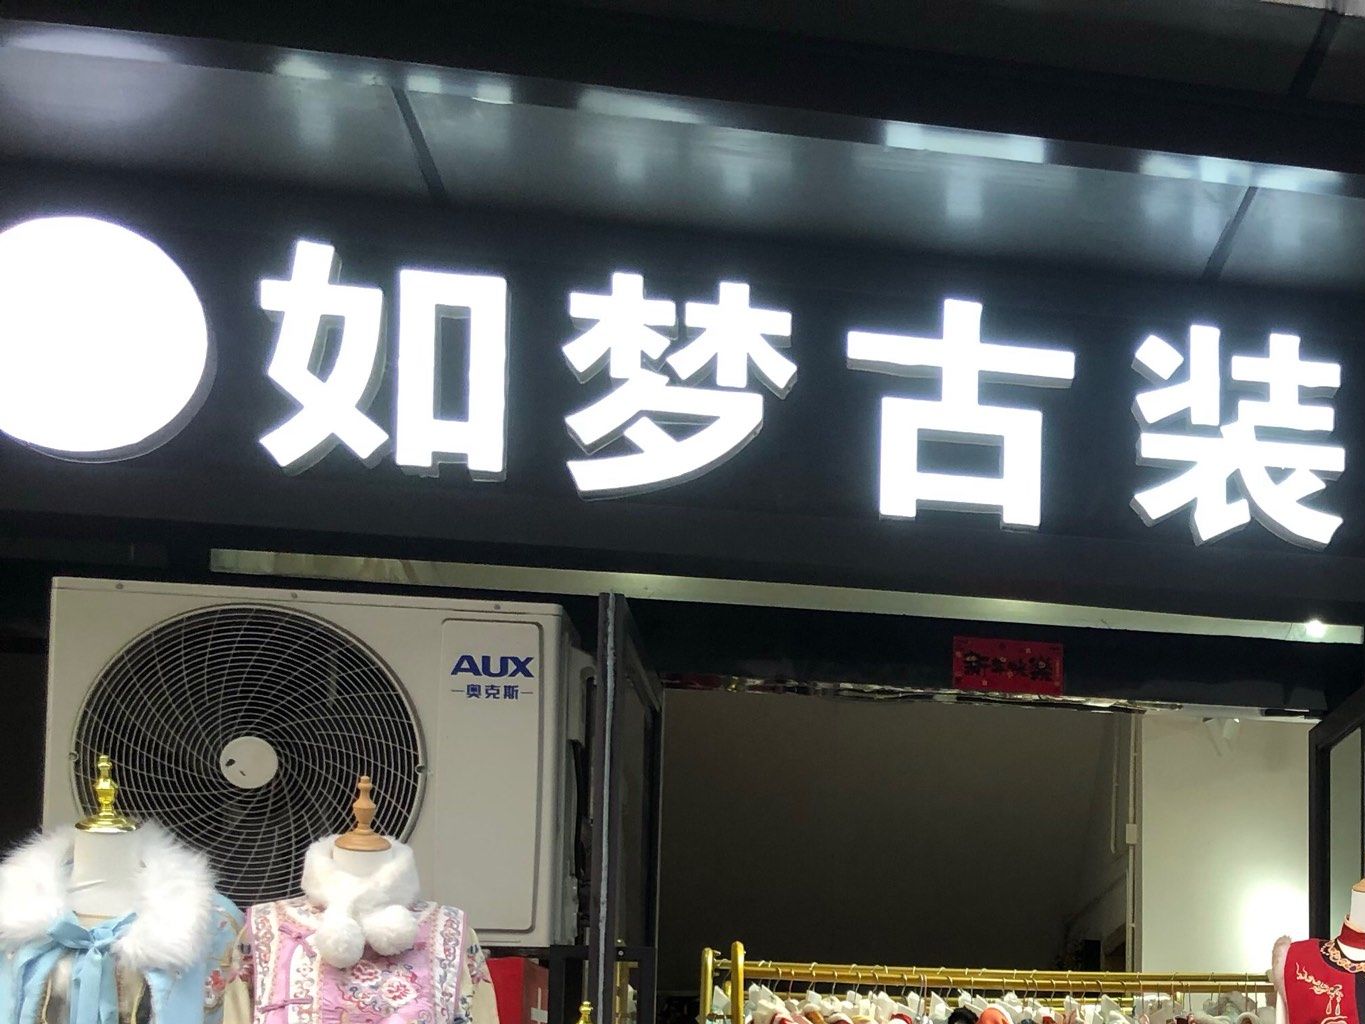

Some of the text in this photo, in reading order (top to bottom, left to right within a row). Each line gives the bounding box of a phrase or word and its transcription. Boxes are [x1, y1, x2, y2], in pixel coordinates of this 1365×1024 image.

[258, 239, 1346, 547] 如梦古装
[450, 655, 534, 678] AUX
[466, 684, 519, 700] 奥克斯
